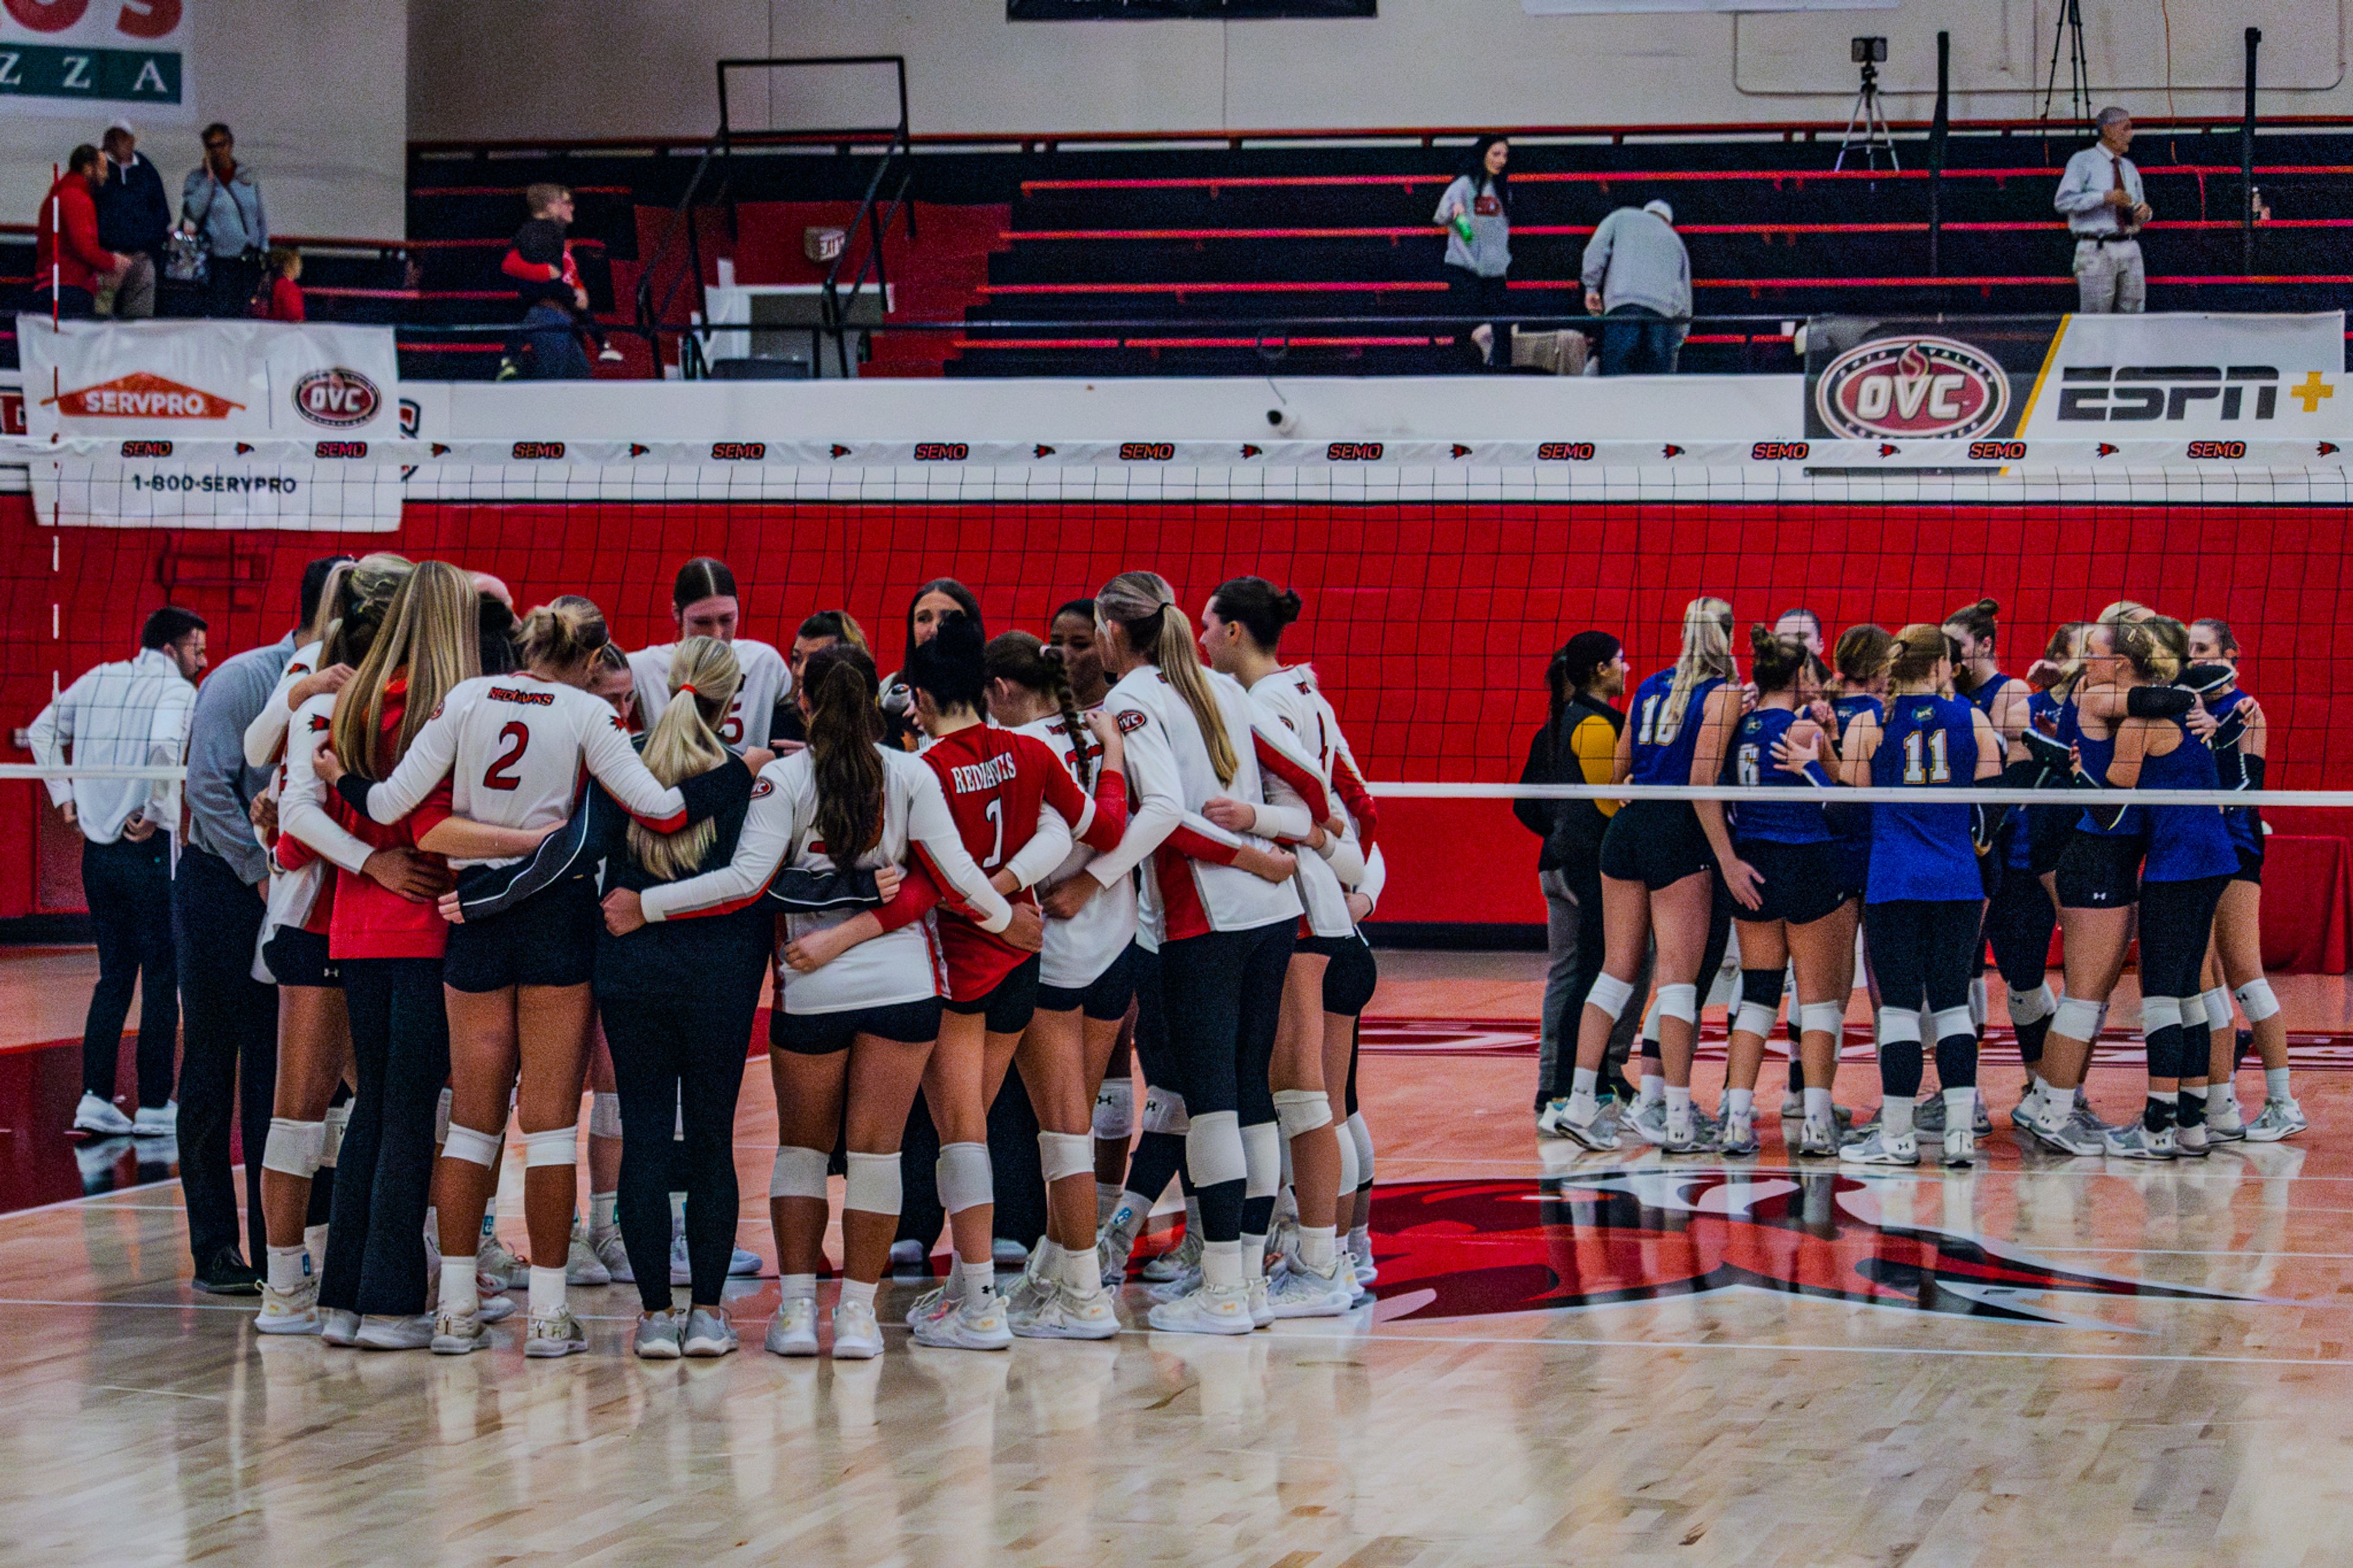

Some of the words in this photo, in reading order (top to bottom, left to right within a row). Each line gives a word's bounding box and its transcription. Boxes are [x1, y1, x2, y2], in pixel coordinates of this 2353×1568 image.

[310, 385, 363, 412] OVC
[1856, 374, 1966, 420] OVC
[2057, 365, 2334, 421] ESPN+
[85, 391, 204, 415] SERVPRO
[121, 440, 173, 458] SEMO
[315, 441, 368, 458] SEMO
[512, 442, 565, 460] SEMO
[711, 442, 766, 460] SEMO
[914, 442, 969, 461] SEMO
[1119, 442, 1175, 461] SEMO
[1327, 442, 1384, 461] SEMO
[1537, 442, 1595, 461] SEMO
[1751, 442, 1809, 460] SEMO
[1968, 441, 2026, 460] SEMO
[2187, 441, 2246, 459] SEMO
[131, 474, 297, 494] 1-800-SERVPRO
[483, 721, 529, 791] 2
[1737, 743, 1760, 786] 6
[1903, 728, 1951, 785] 11
